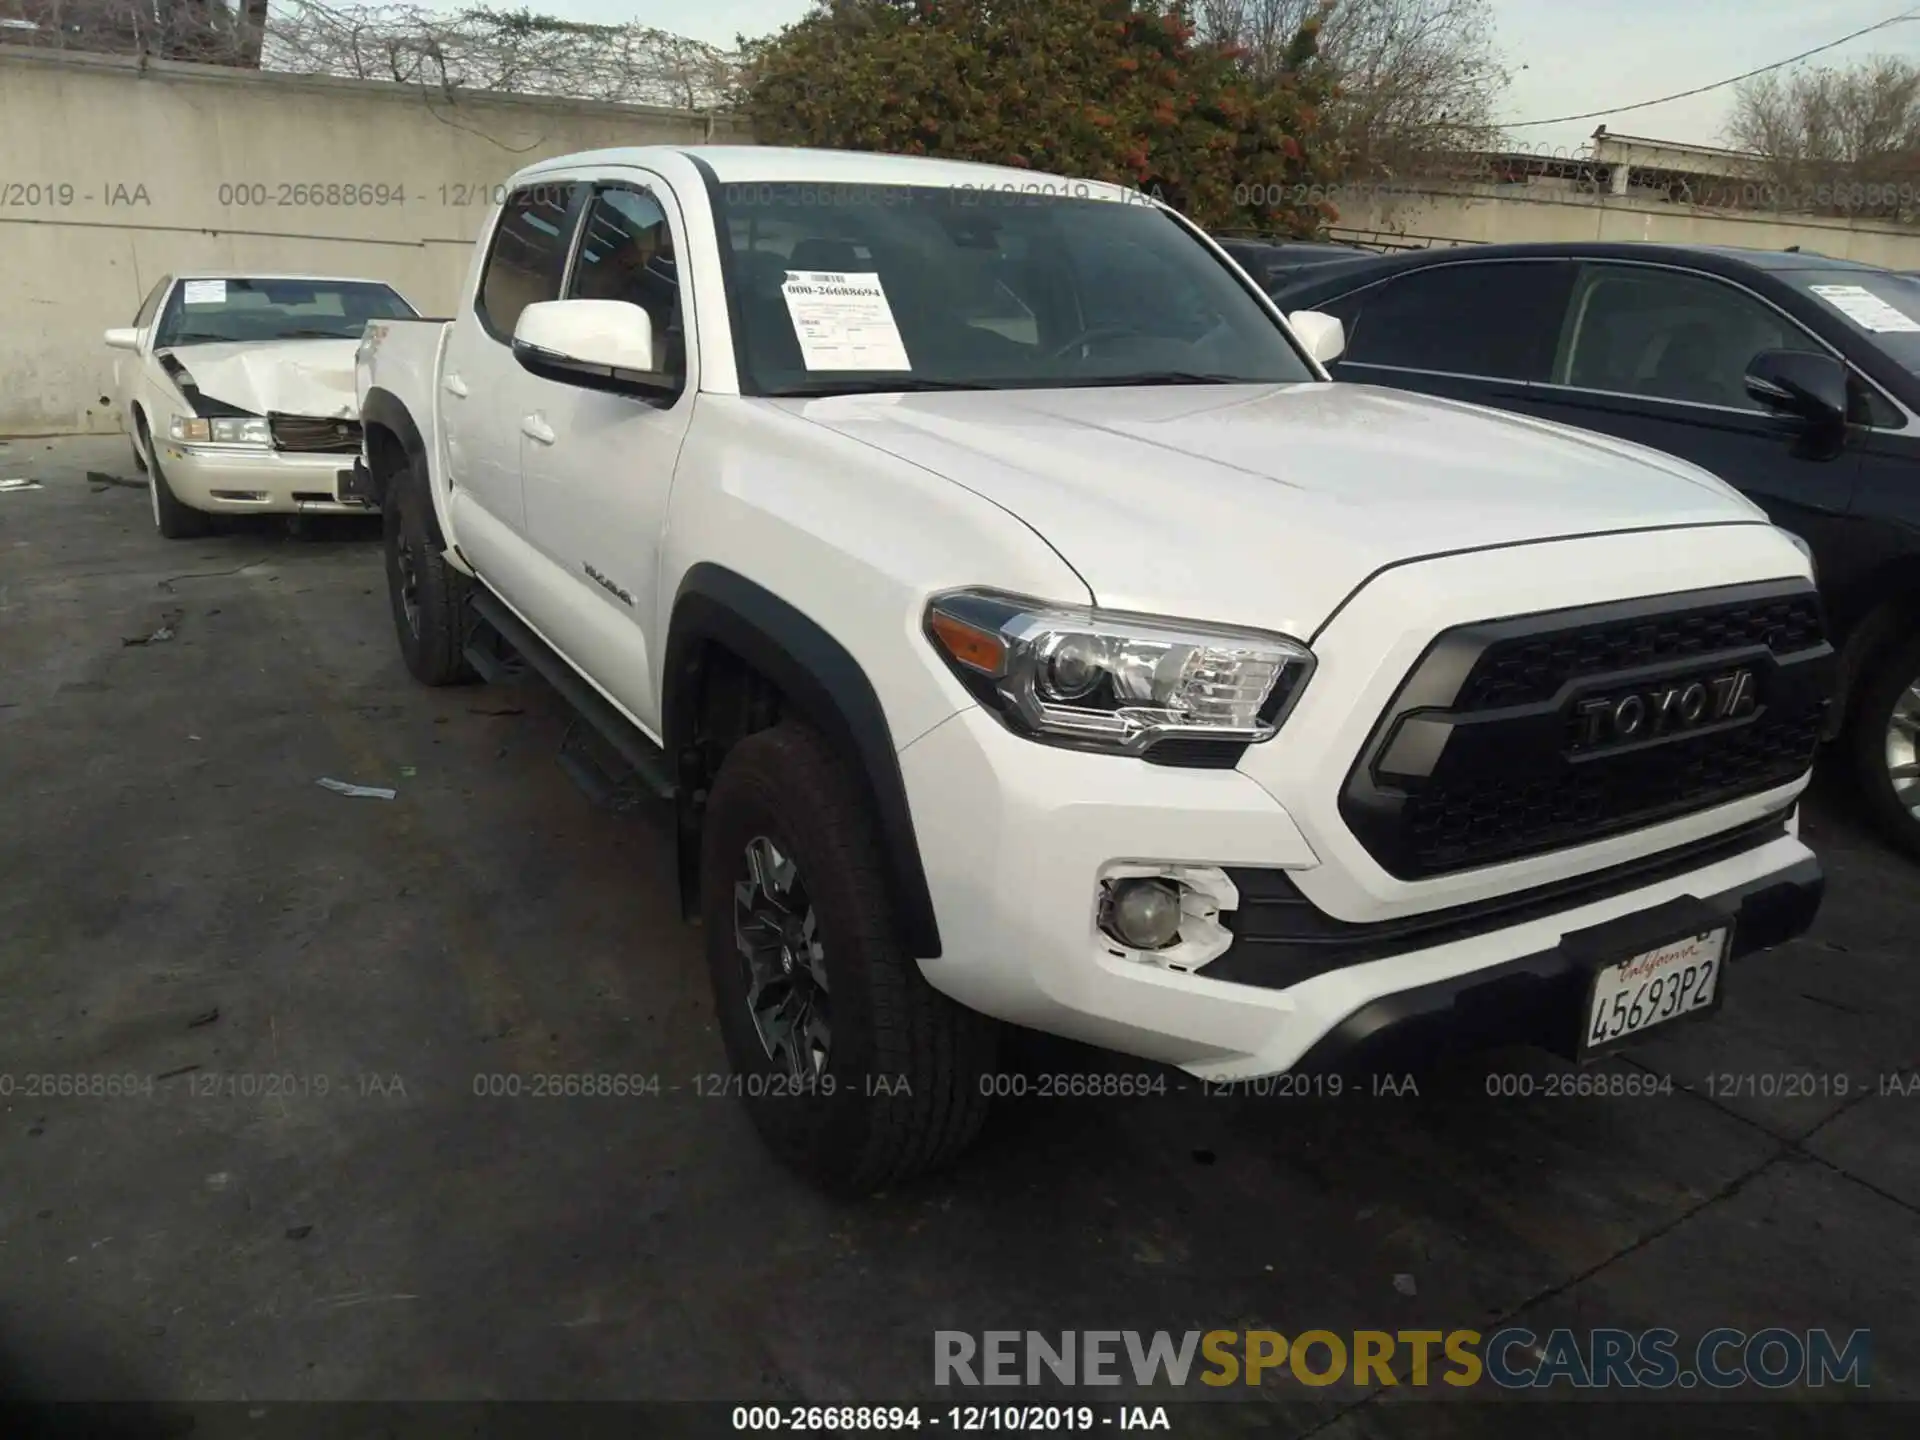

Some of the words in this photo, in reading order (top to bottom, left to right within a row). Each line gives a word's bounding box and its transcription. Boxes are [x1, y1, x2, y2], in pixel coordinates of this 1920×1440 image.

[787, 285, 881, 297] 000-26688694
[1579, 671, 1756, 744] TOYOTA
[1592, 960, 1713, 1042] 45693P2
